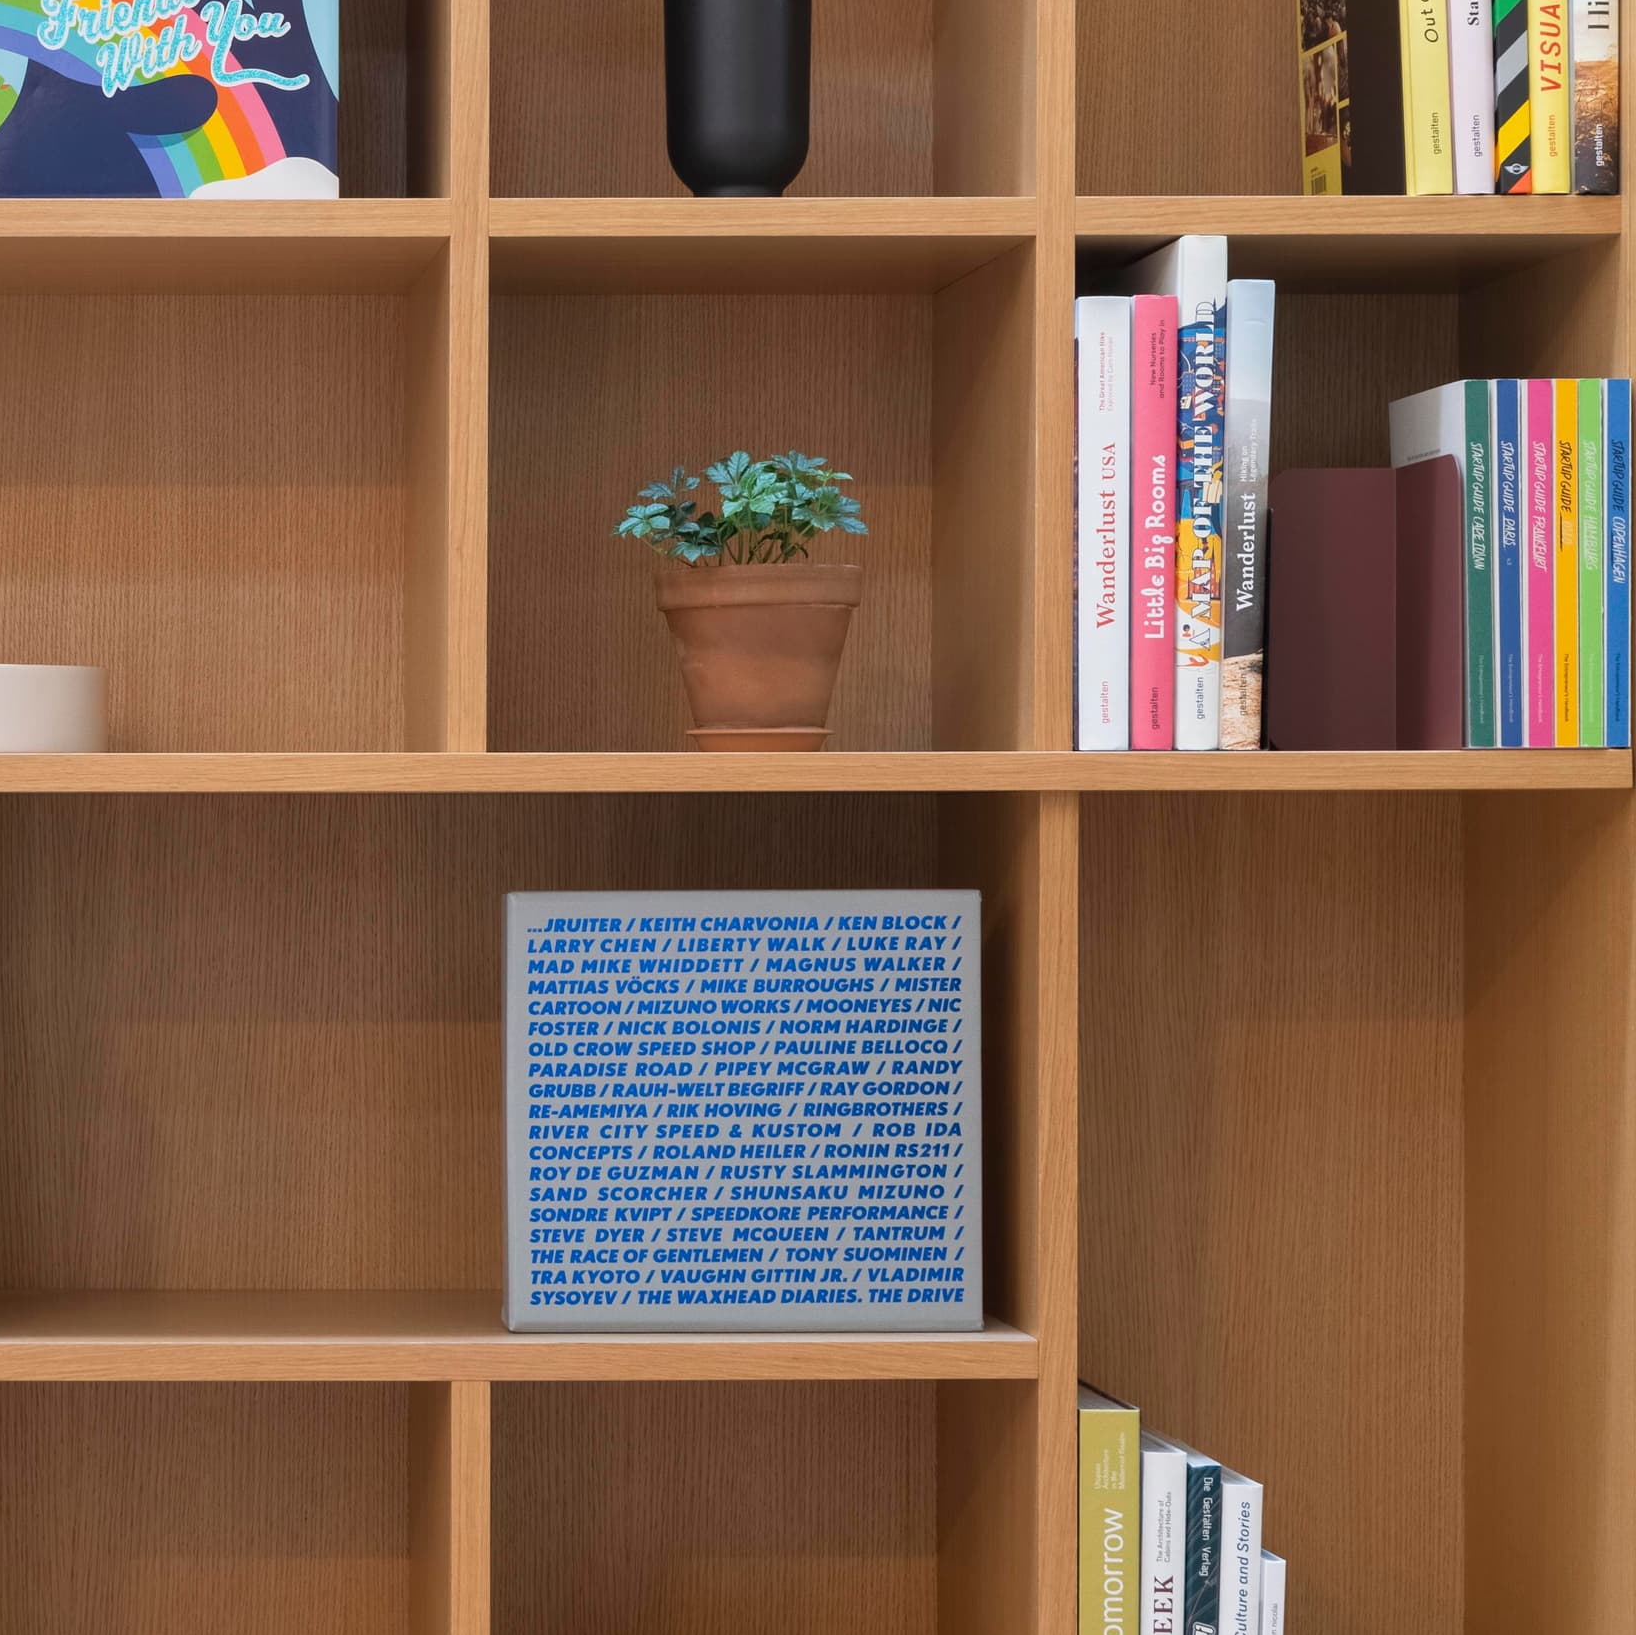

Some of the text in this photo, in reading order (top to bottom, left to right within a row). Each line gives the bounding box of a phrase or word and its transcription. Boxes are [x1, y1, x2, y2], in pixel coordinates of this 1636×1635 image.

[1420, 9, 1439, 42] Out
[96, 15, 202, 97] With
[201, 0, 310, 90] You
[1189, 301, 1214, 649] A MAP OF THE WORLD
[1470, 442, 1484, 482] STARTUP
[1473, 482, 1484, 512] GUIDE
[1611, 440, 1626, 584] STARTUP GUIDE COPENHAGEN
[1095, 443, 1116, 628] Wanderlust USA
[1472, 516, 1485, 540] CAPE
[1141, 455, 1173, 639] Little Big Rooms
[1236, 493, 1255, 611] Wanderlust
[639, 916, 697, 933] KEITH
[700, 915, 820, 932] CHARVONIA
[837, 915, 878, 932] KEN
[881, 915, 946, 931] BLOCK
[527, 976, 961, 996] MATTIAS VÖCKS MIKE BURROUGHS MISTER
[528, 997, 961, 1016] CARTOON MIZUNO WORKS MOONEYES NIC
[528, 1039, 948, 1058] OLD CROW SPEED SHOP PAULINE BELLOCQ
[528, 1080, 950, 1099] GRUBB RAUH-WELT BEGRIFF RAY GORDON
[529, 1143, 950, 1161] CONCEPTS ROLAND HEILER RONIN RS211
[530, 1246, 948, 1265] THE RACE OF GENTLEMEN TONY SUOMINEN
[530, 1287, 964, 1306] SYSOYEV THE WAXHEAD DIARIES. THE DRIVE
[1237, 1502, 1250, 1552] Stories
[1237, 1557, 1249, 1584] and
